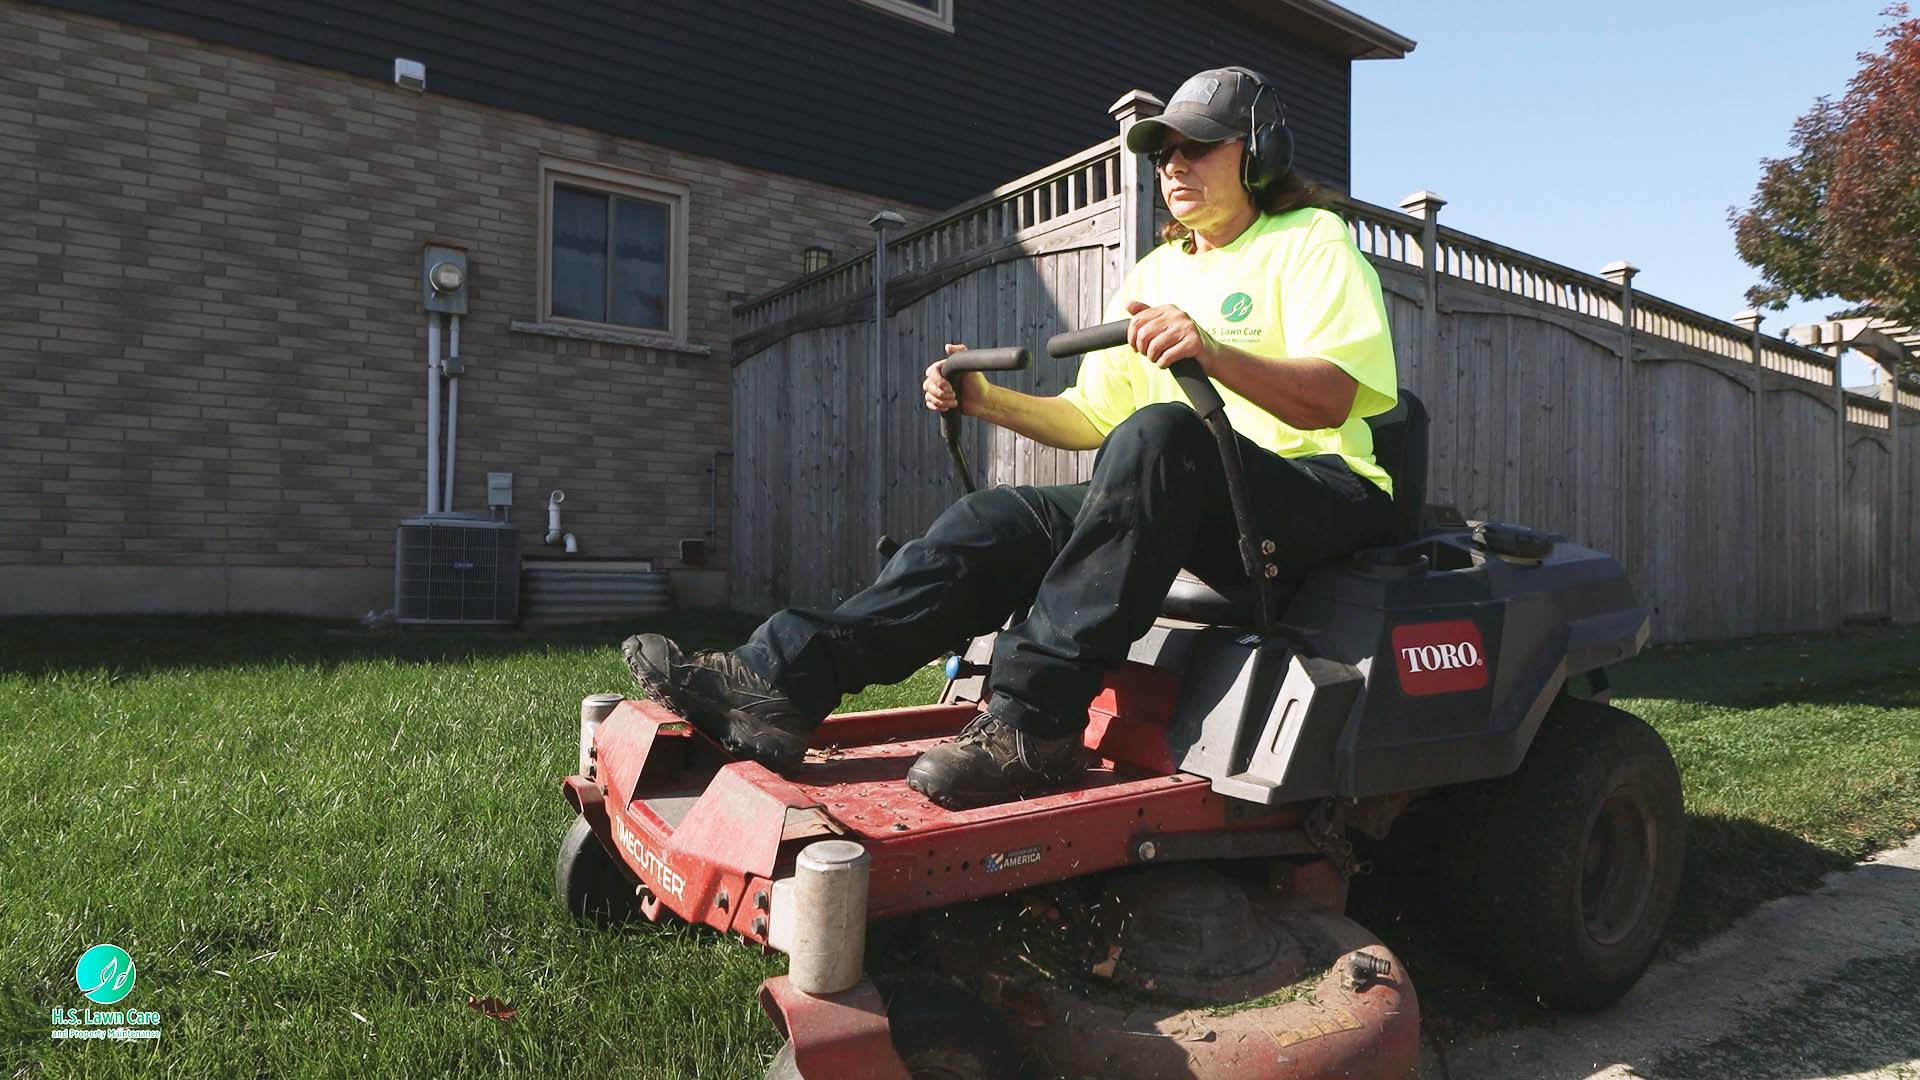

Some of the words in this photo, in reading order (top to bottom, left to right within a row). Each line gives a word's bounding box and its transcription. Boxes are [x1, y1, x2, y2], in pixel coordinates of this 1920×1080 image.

[1220, 327, 1242, 336] Lawn
[1243, 327, 1262, 336] Care
[615, 814, 685, 902] TIMECUTTER
[1003, 852, 1041, 868] AMERICA
